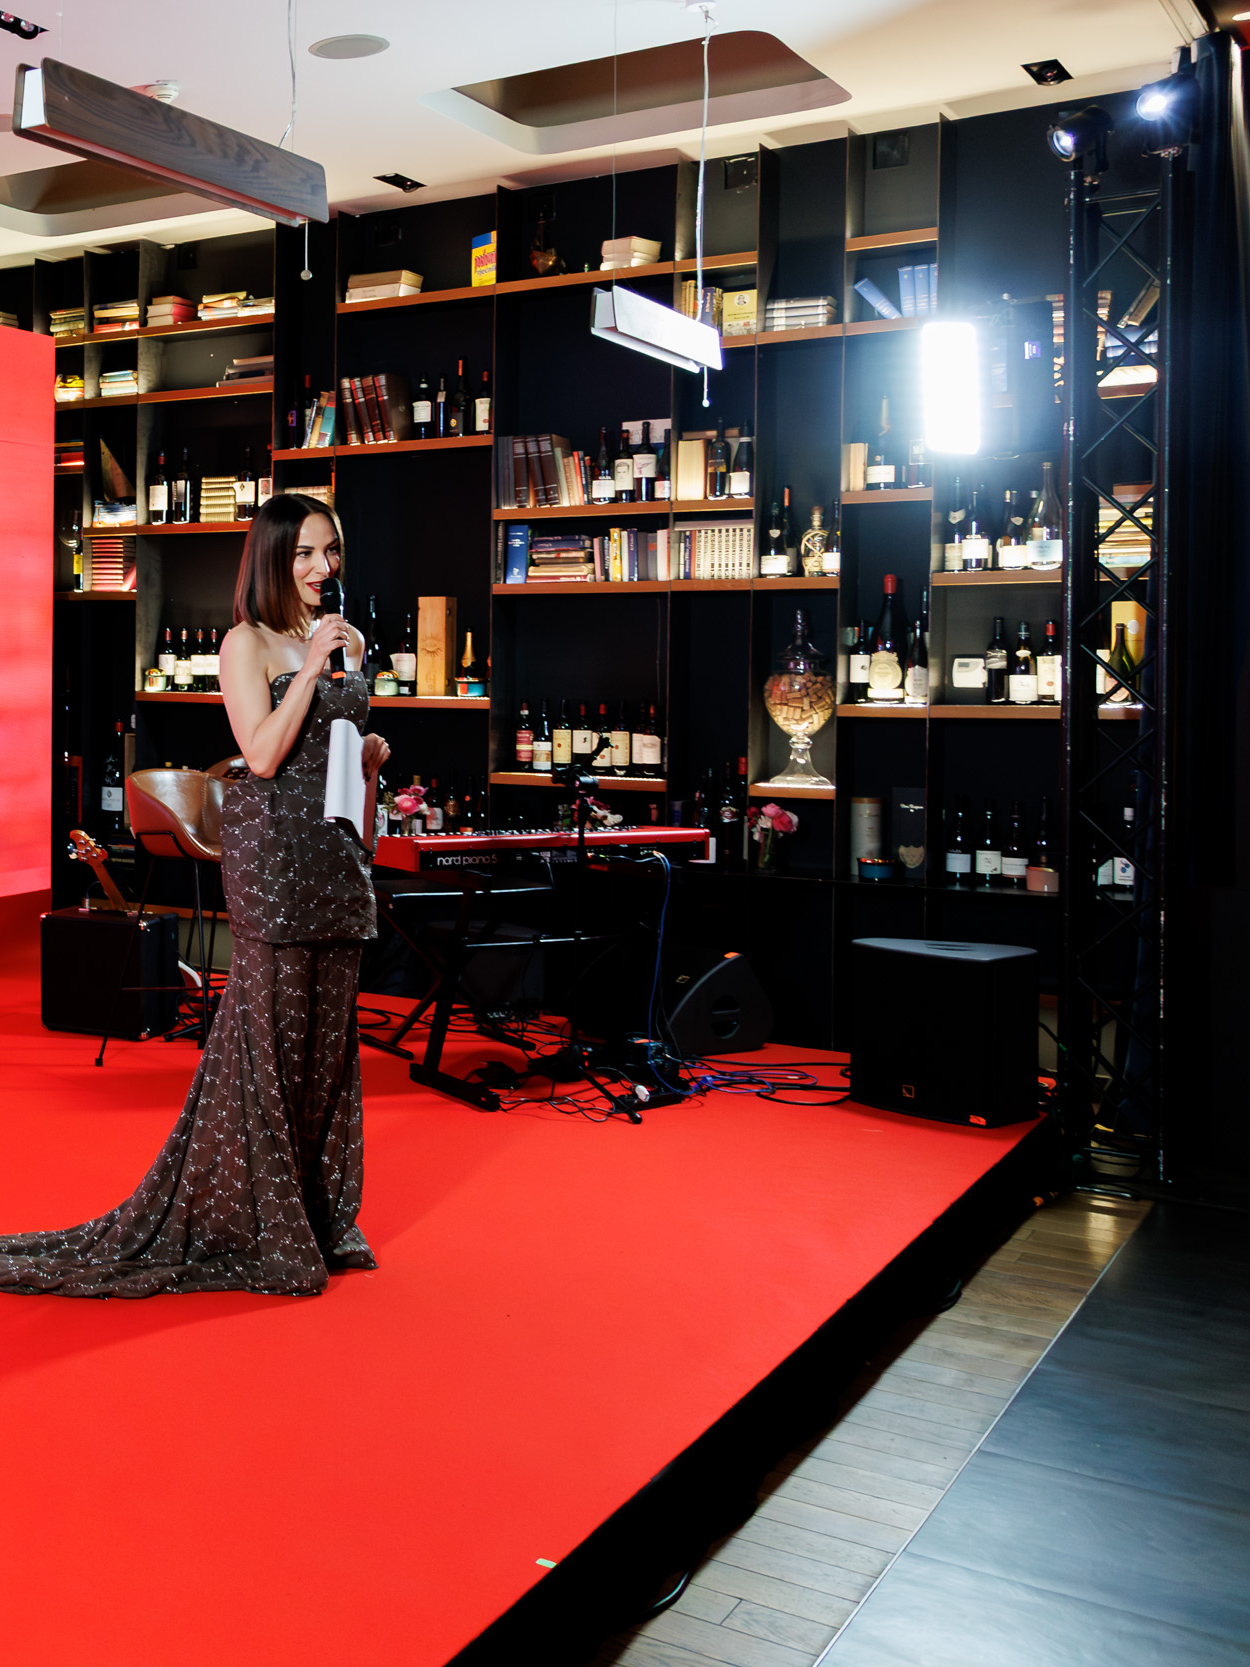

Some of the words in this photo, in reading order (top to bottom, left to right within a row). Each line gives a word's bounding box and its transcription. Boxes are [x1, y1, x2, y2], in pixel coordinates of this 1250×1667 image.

[436, 855, 461, 866] nord
[462, 855, 490, 866] piano
[491, 853, 498, 864] 5
